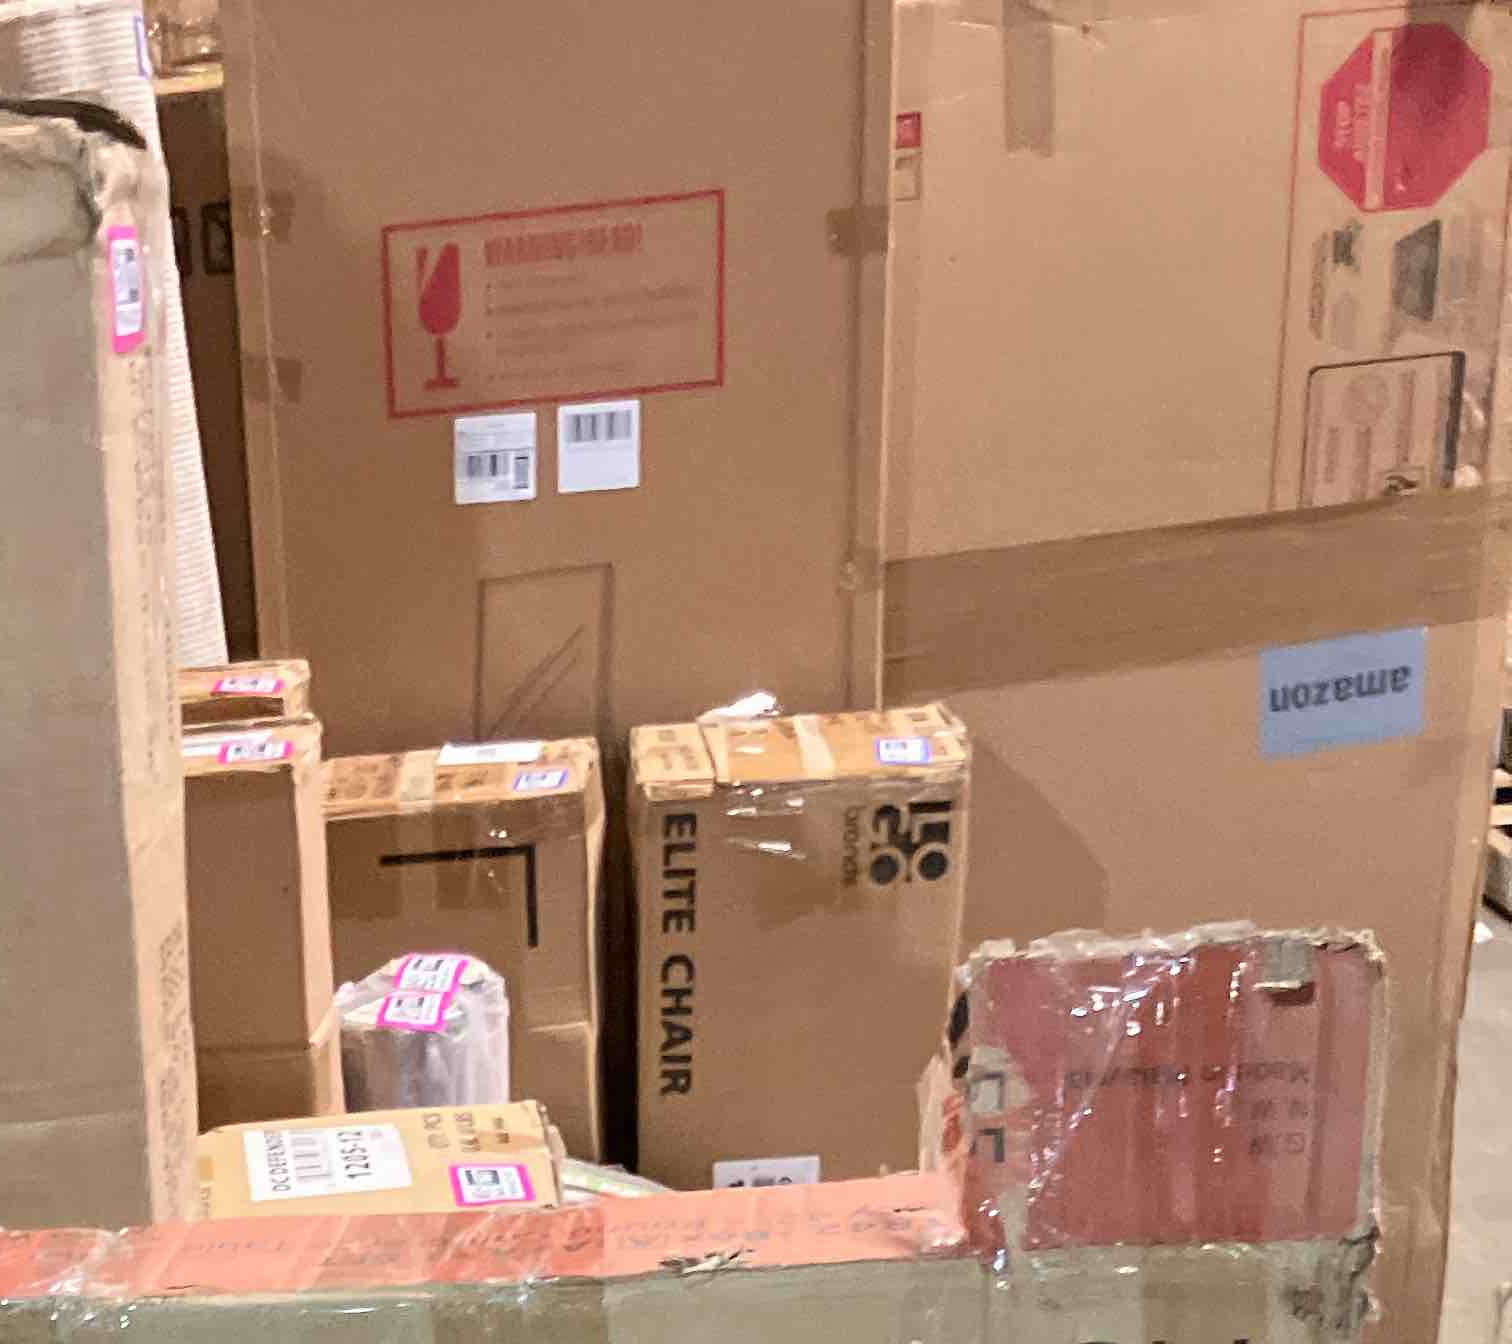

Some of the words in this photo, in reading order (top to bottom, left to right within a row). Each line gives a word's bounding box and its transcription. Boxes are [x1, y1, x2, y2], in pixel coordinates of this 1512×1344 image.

[1269, 666, 1412, 713] amazon
[662, 812, 697, 934] ELITE
[659, 953, 695, 1097] CHAIR
